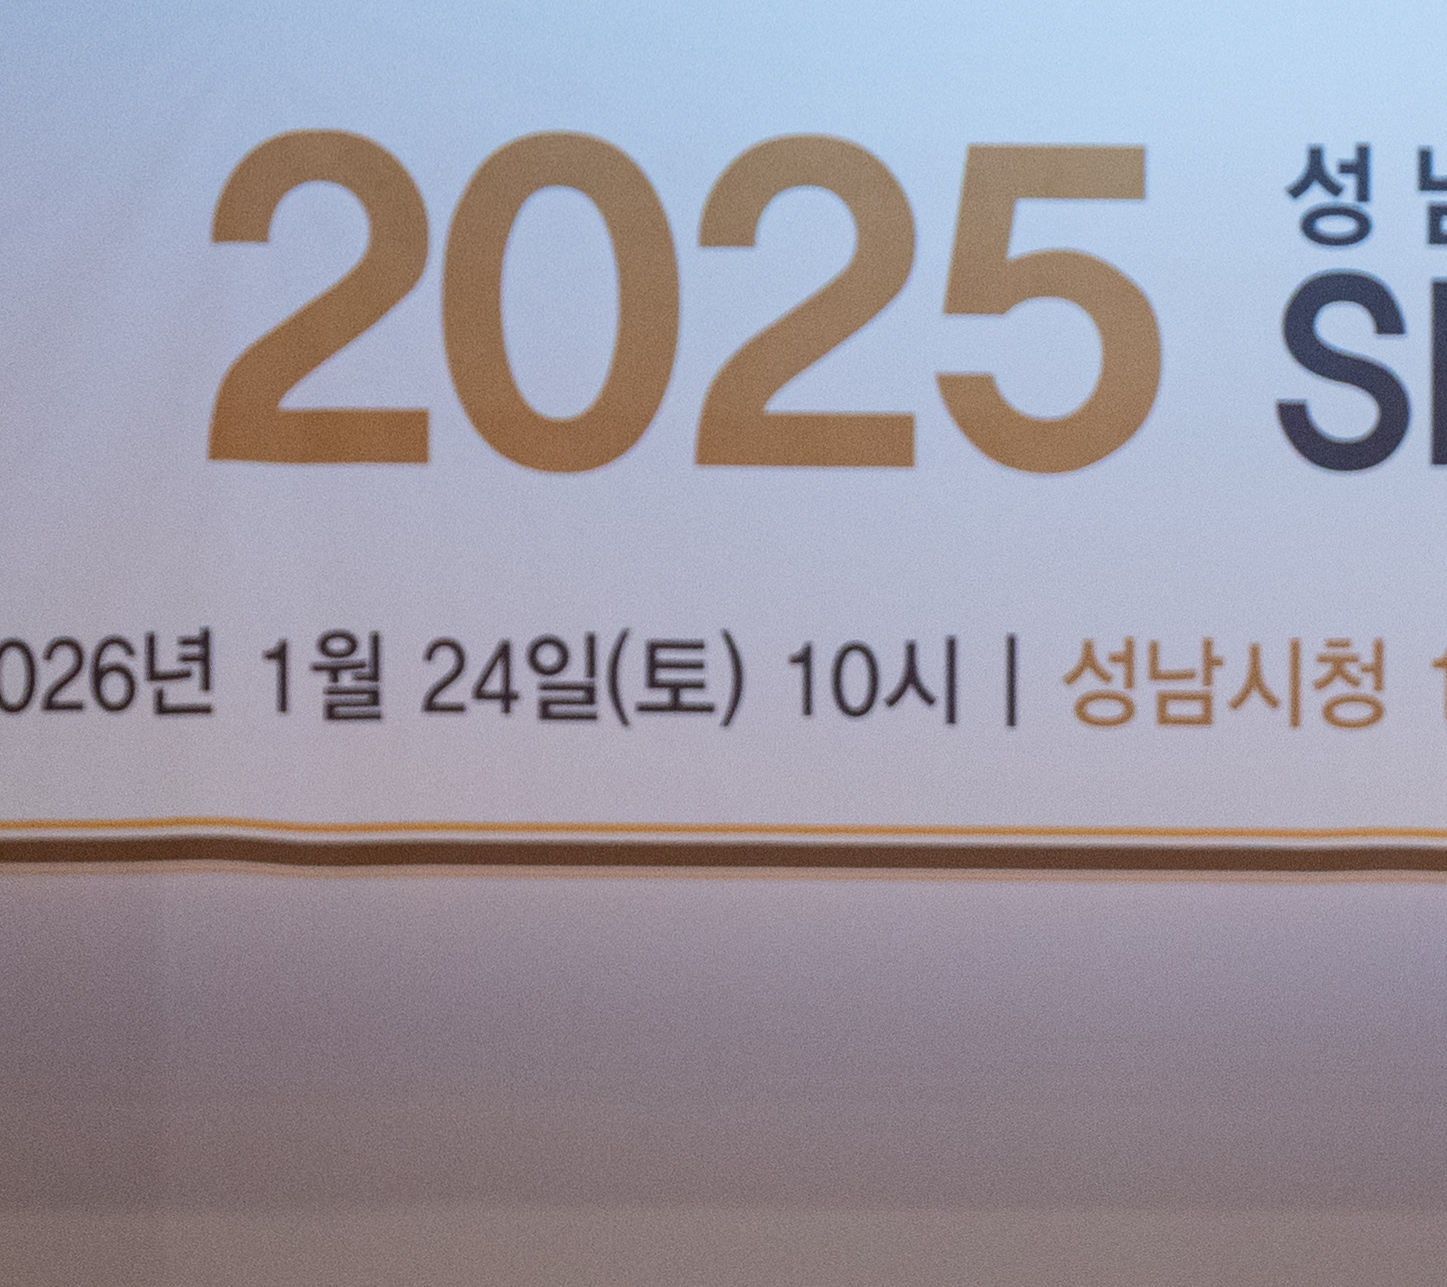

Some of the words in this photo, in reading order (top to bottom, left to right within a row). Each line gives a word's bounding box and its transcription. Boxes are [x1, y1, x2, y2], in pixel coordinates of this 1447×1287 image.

[206, 128, 1162, 475] 2025
[261, 627, 385, 724] 1월
[418, 627, 749, 729] 24일(토)
[786, 634, 958, 726] 10시
[1062, 635, 1388, 730] 성남시청
